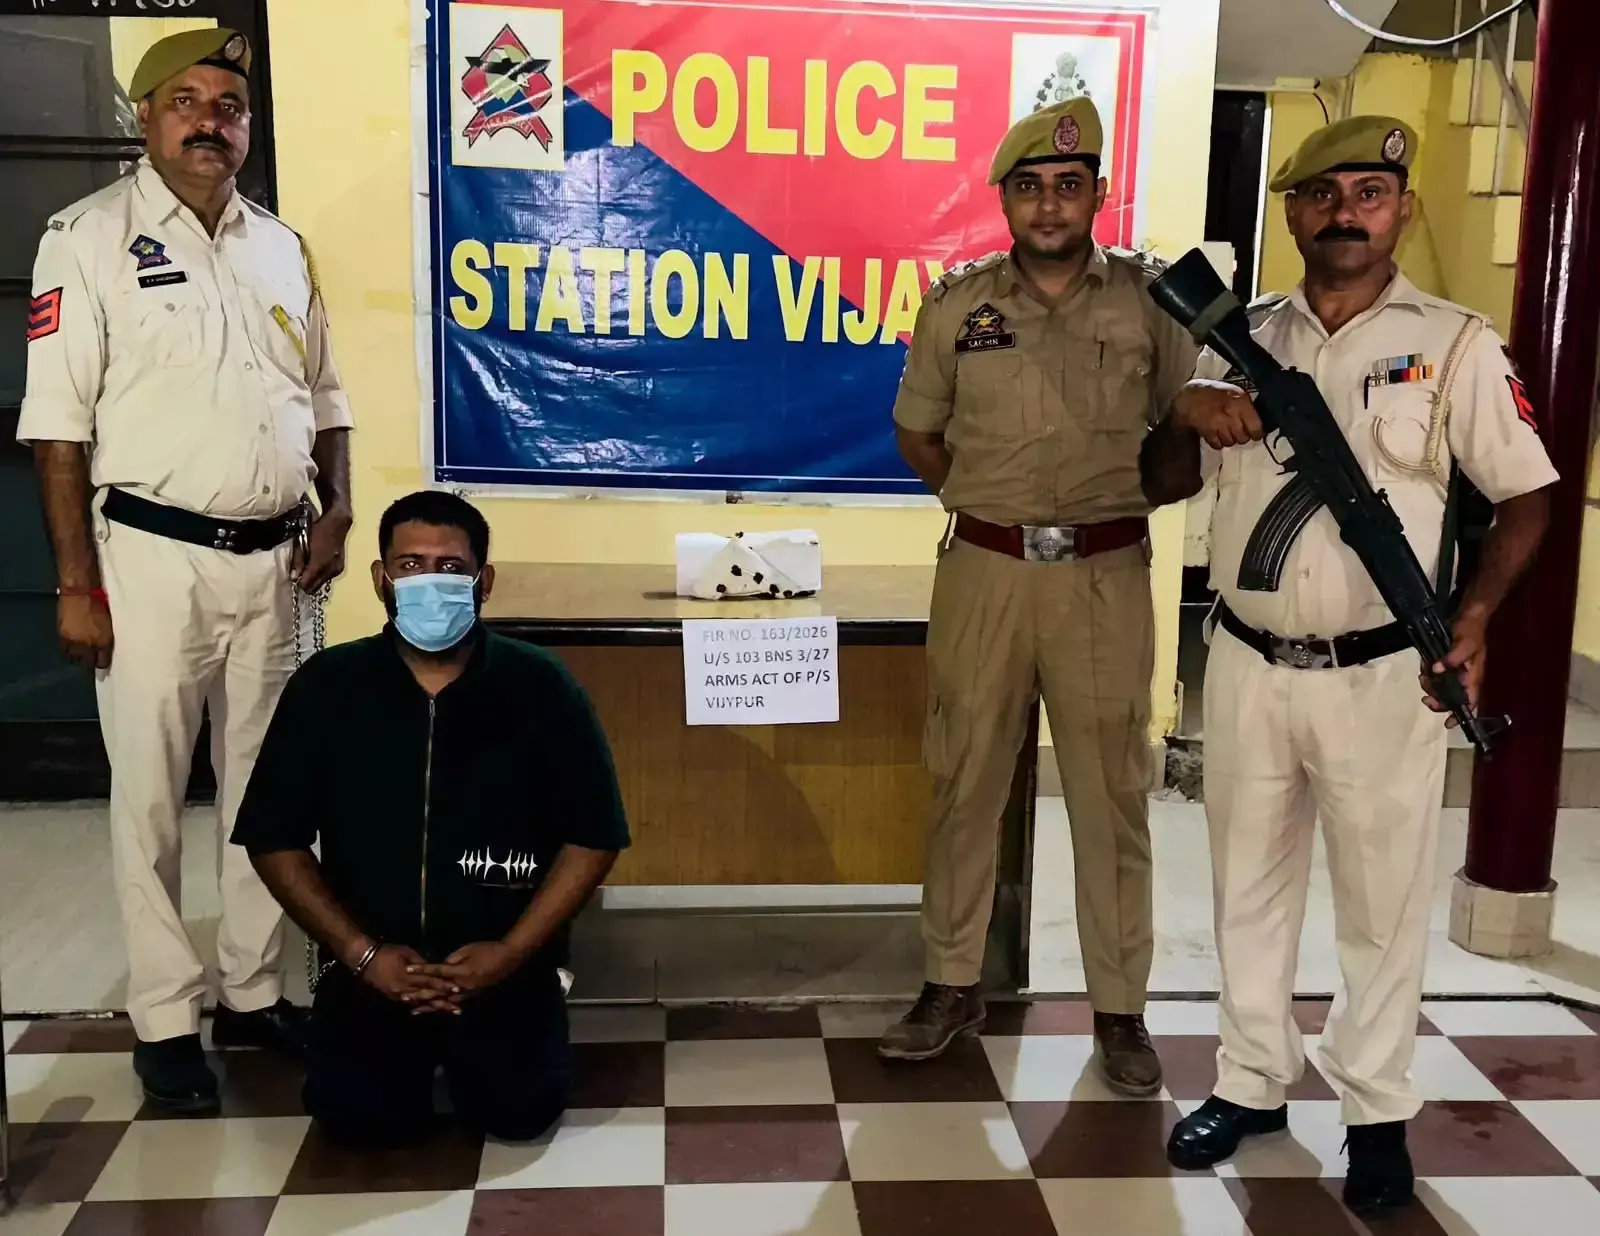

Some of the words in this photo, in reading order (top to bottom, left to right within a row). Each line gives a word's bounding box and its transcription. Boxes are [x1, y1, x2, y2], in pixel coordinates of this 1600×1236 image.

[612, 49, 958, 161] POLICE
[449, 238, 750, 340] STATION
[967, 338, 999, 348] SACHIN
[703, 629, 725, 642] FIR
[729, 628, 756, 641] NO.
[761, 626, 828, 641] 163/2026
[704, 651, 730, 666] U/S
[736, 651, 760, 664] 103
[765, 650, 793, 662] BNS
[797, 648, 830, 663] 3/27
[705, 674, 748, 687] ARMS
[752, 672, 779, 685] ACT
[783, 671, 802, 684] OF
[807, 669, 831, 684] P/S
[705, 695, 765, 709] VIJYPUR
